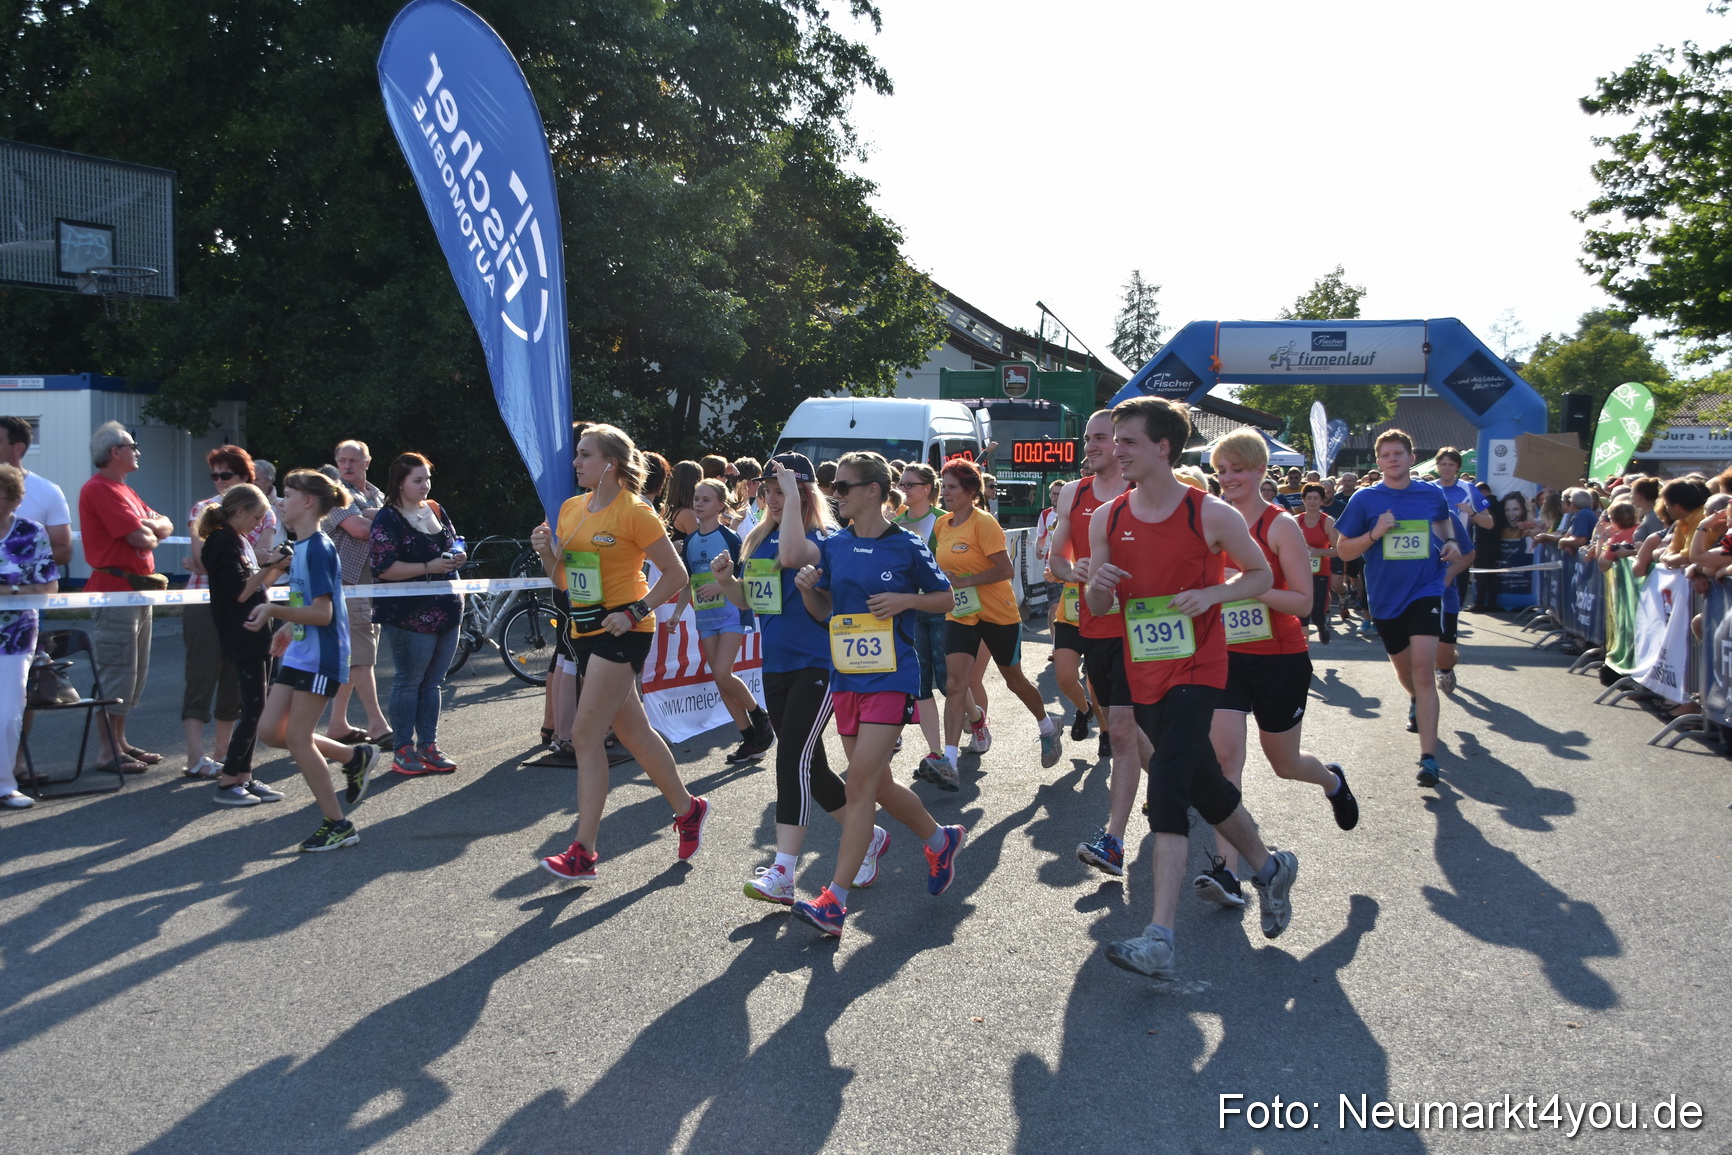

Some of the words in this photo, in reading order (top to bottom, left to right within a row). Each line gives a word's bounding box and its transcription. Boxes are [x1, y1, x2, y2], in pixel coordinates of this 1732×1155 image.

[1298, 351, 1377, 366] firmenlauf
[1153, 379, 1194, 388] Fischer
[1664, 431, 1695, 441] Jura
[1014, 442, 1074, 463] 00:02:40
[1594, 436, 1622, 466] AOK
[853, 546, 874, 554] hummel
[1392, 535, 1420, 549] 736
[571, 571, 586, 590] 70
[748, 580, 773, 599] 724
[1133, 619, 1185, 644] 1391
[842, 637, 882, 657] 763
